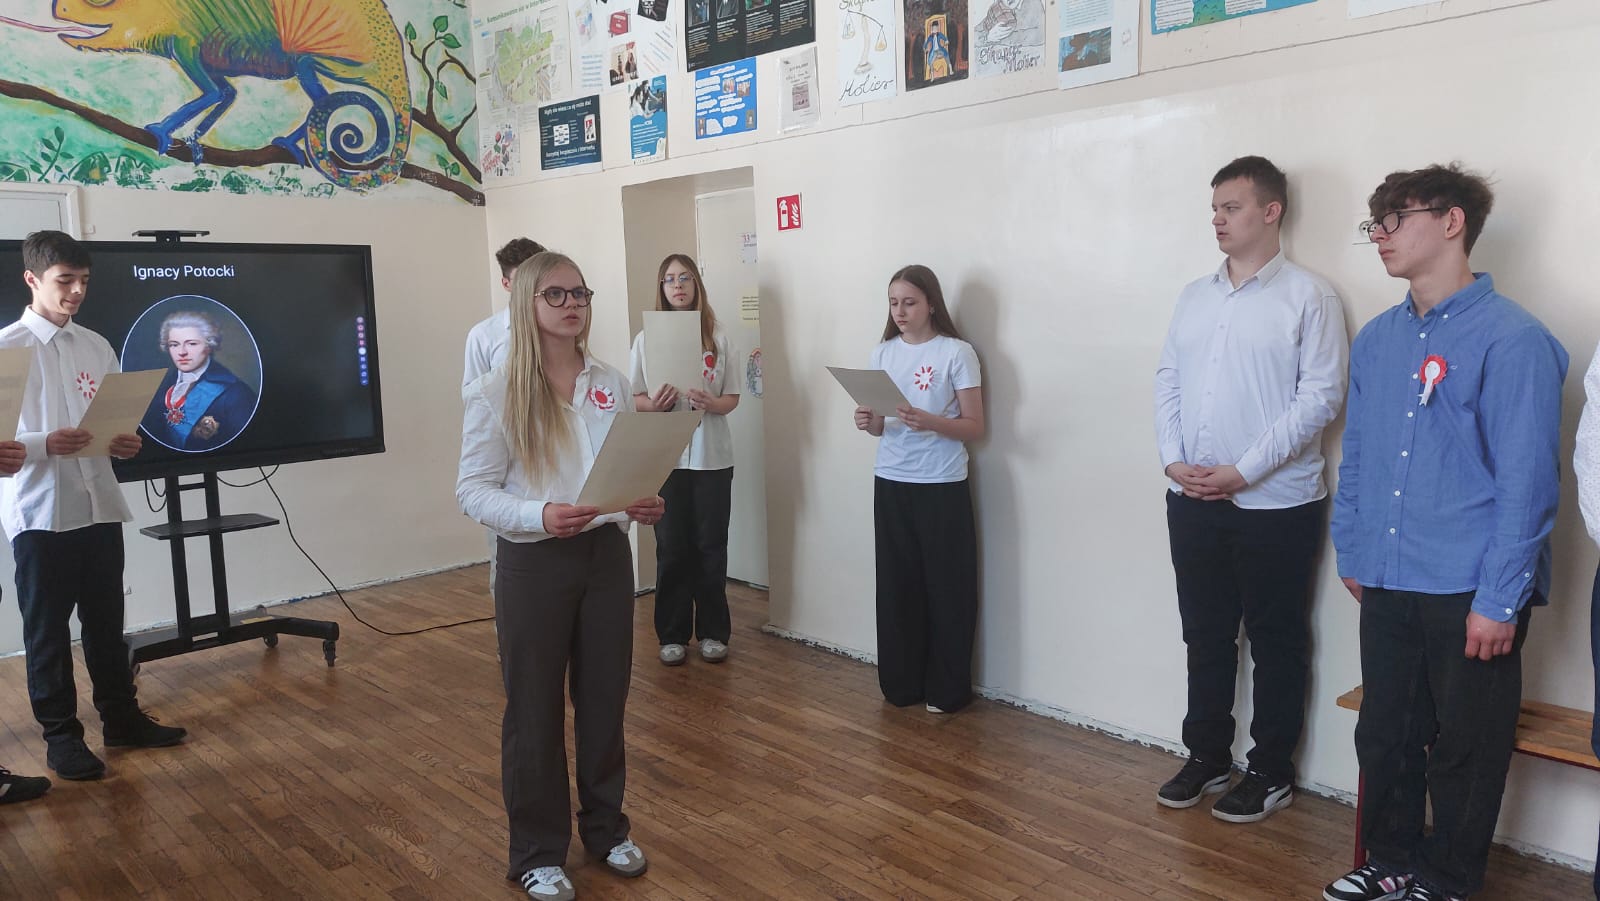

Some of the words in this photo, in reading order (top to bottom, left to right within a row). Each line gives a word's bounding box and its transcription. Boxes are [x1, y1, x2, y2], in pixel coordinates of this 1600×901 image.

[839, 74, 894, 101] Molier
[133, 265, 180, 280] Ignacy
[184, 264, 235, 278] Potocki
